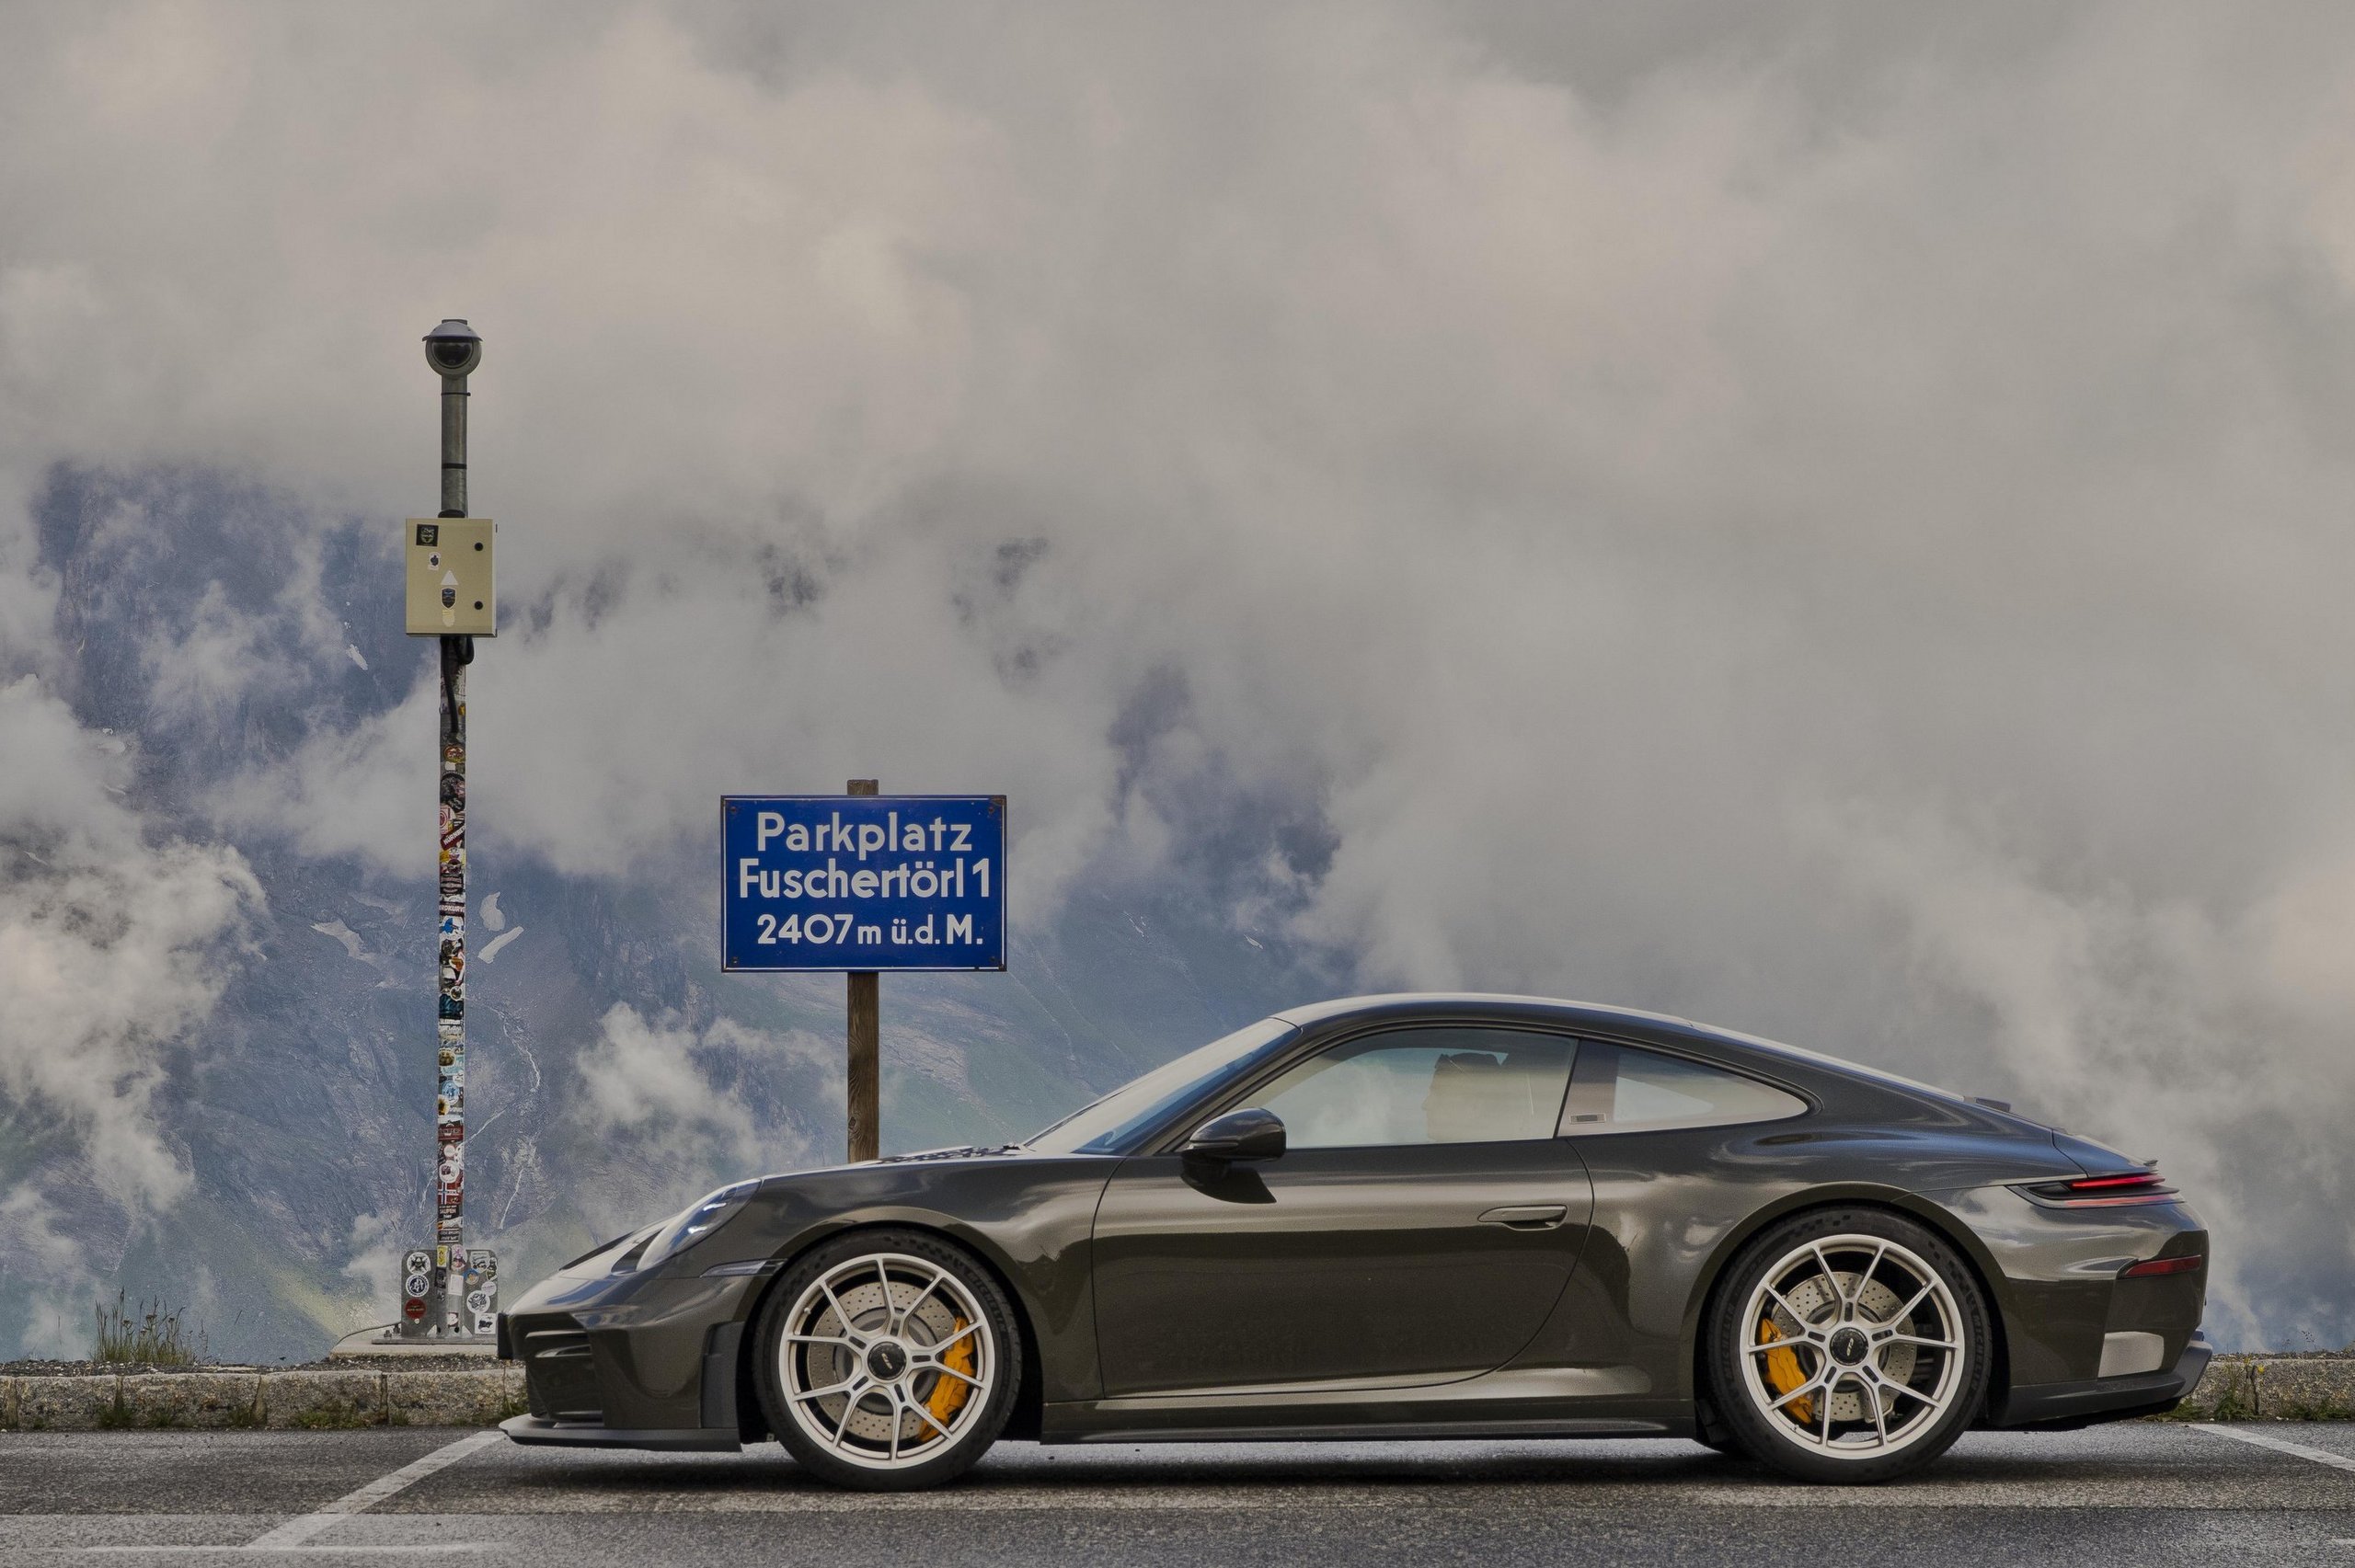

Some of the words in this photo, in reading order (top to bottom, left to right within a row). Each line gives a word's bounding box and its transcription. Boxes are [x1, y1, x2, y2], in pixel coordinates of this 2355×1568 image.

[757, 811, 972, 861] Parkplatz
[740, 858, 964, 898] Fuschertörl
[971, 858, 990, 898] 1
[757, 913, 854, 944] 2407
[857, 925, 882, 944] m
